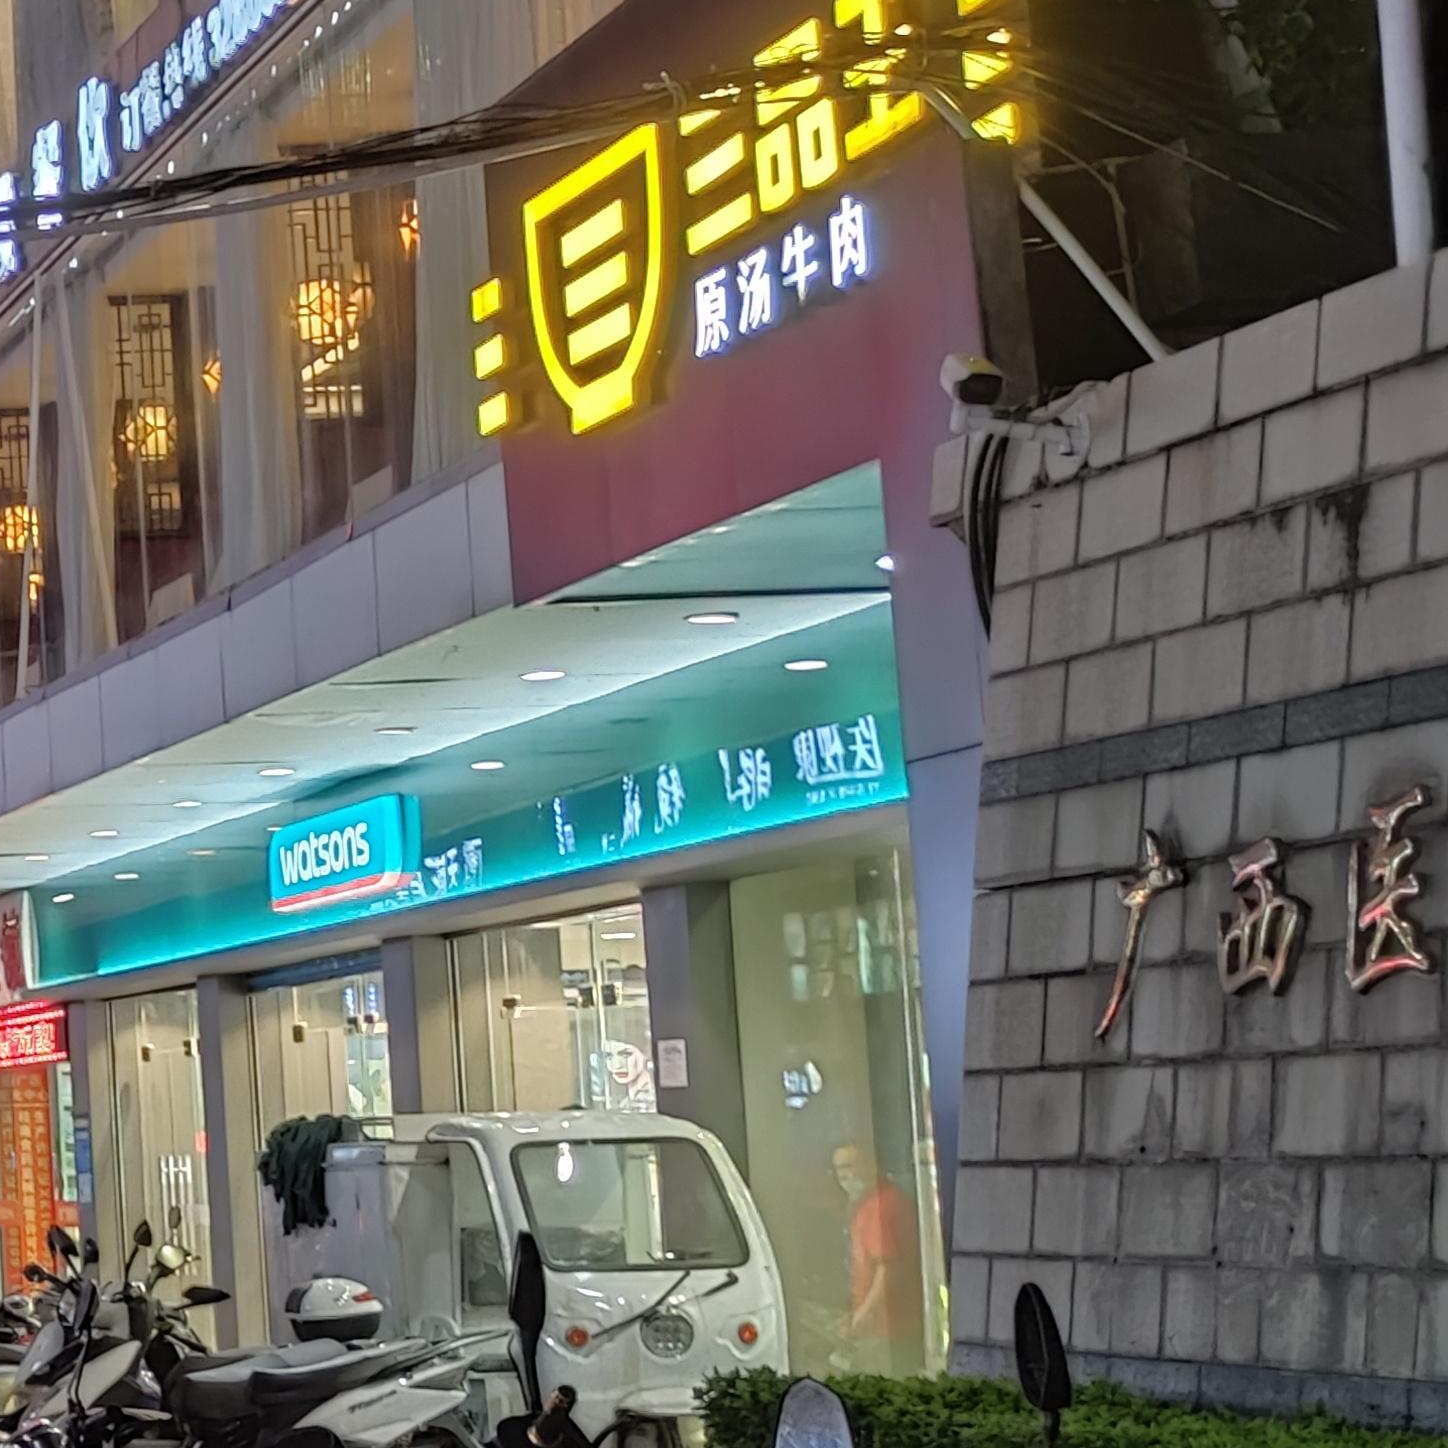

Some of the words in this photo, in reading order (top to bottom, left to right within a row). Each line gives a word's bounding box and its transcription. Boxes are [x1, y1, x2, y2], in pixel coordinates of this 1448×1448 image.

[694, 195, 871, 358] 原汤牛肉
[279, 821, 370, 887] watsons
[1093, 784, 1434, 1042] 广西医
